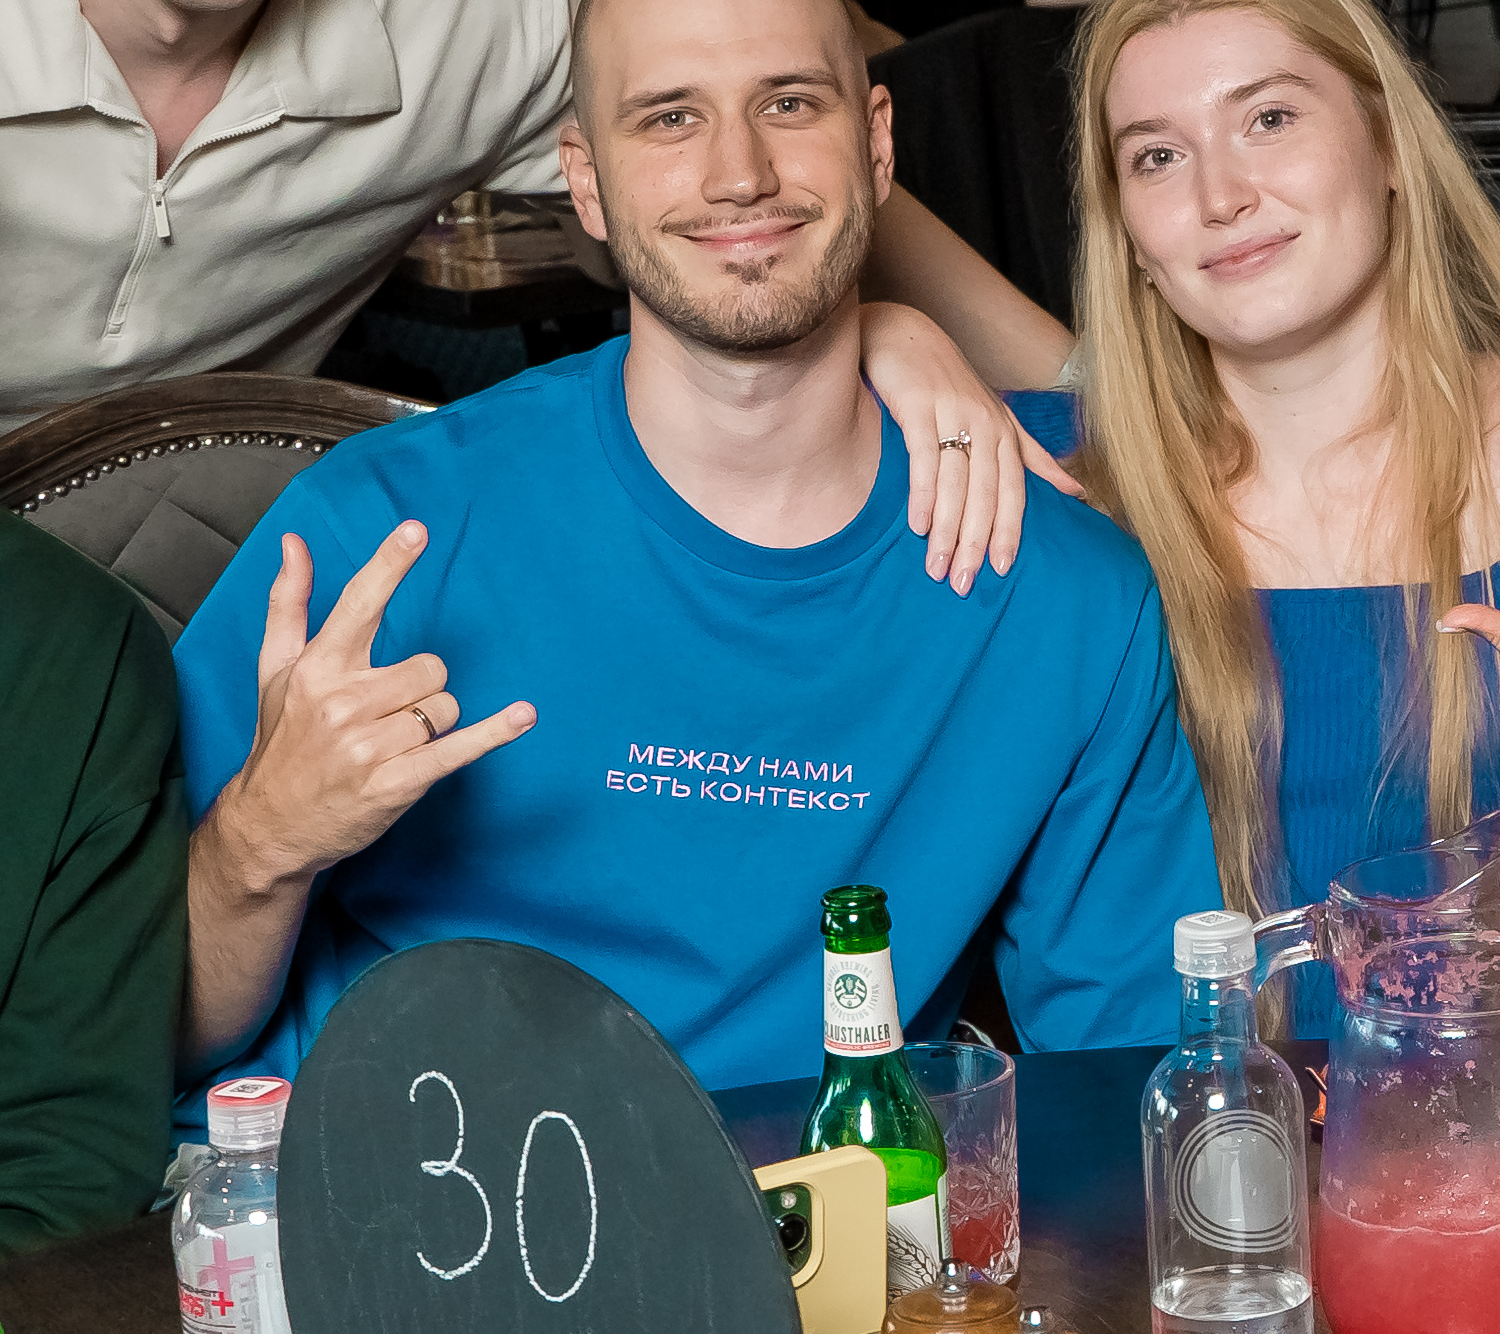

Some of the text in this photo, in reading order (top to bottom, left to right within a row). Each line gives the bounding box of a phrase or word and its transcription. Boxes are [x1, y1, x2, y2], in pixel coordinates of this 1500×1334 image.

[628, 743, 853, 783] МЕЖДУ НАМИ
[606, 769, 871, 811] ЕСТЬ КОНТЕКСТ
[408, 1069, 598, 1304] 30
